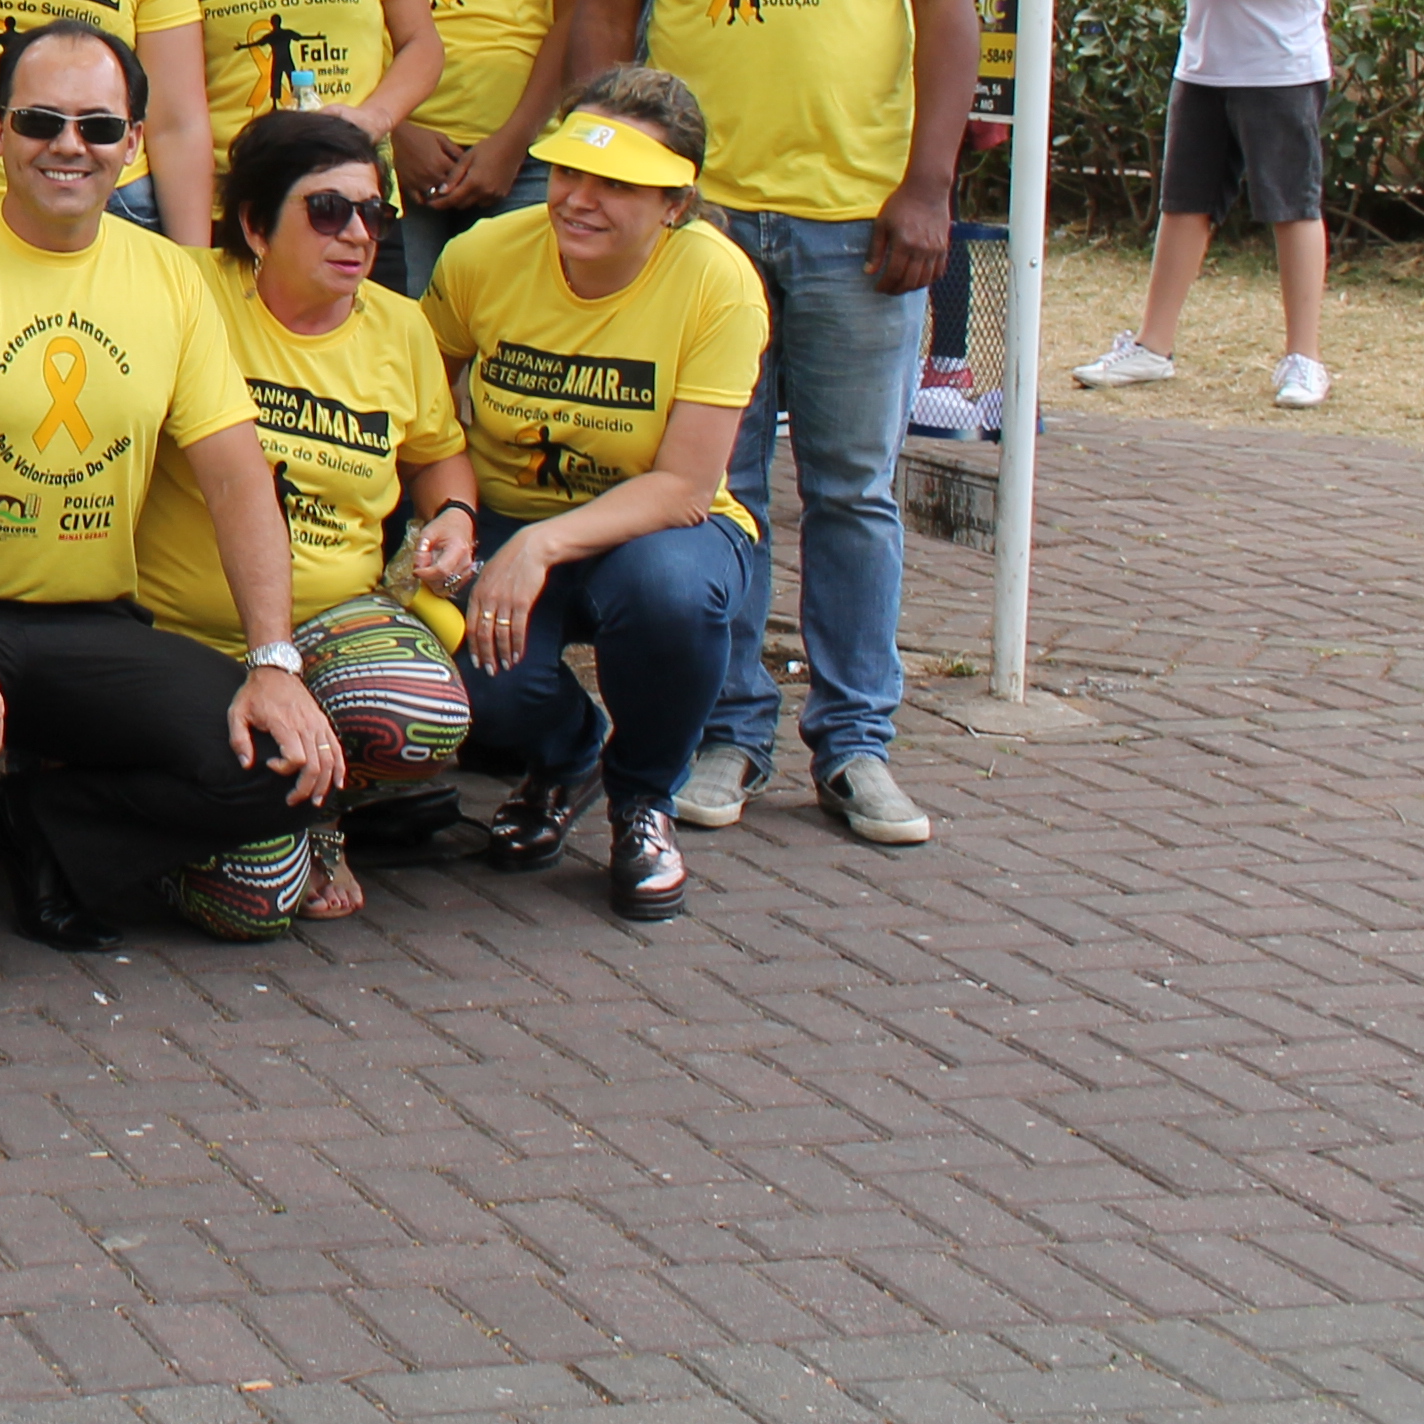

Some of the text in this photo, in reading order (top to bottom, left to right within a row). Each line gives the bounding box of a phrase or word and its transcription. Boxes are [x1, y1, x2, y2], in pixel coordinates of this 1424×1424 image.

[41, 2, 102, 26] Suicídio
[300, 42, 348, 63] Falar
[317, 64, 349, 75] melhor
[68, 310, 131, 376] Amarelo
[481, 361, 652, 404] SETEMBRO AMARELO
[298, 399, 390, 451] AMARELO
[482, 391, 633, 433] Prevenção do Suicídio
[13, 456, 84, 488] Valorização
[86, 460, 104, 478] Da
[101, 434, 132, 462] Vida
[293, 445, 373, 478] do Suicídio
[63, 493, 115, 508] POLÍCIA
[59, 512, 111, 531] CIVIL
